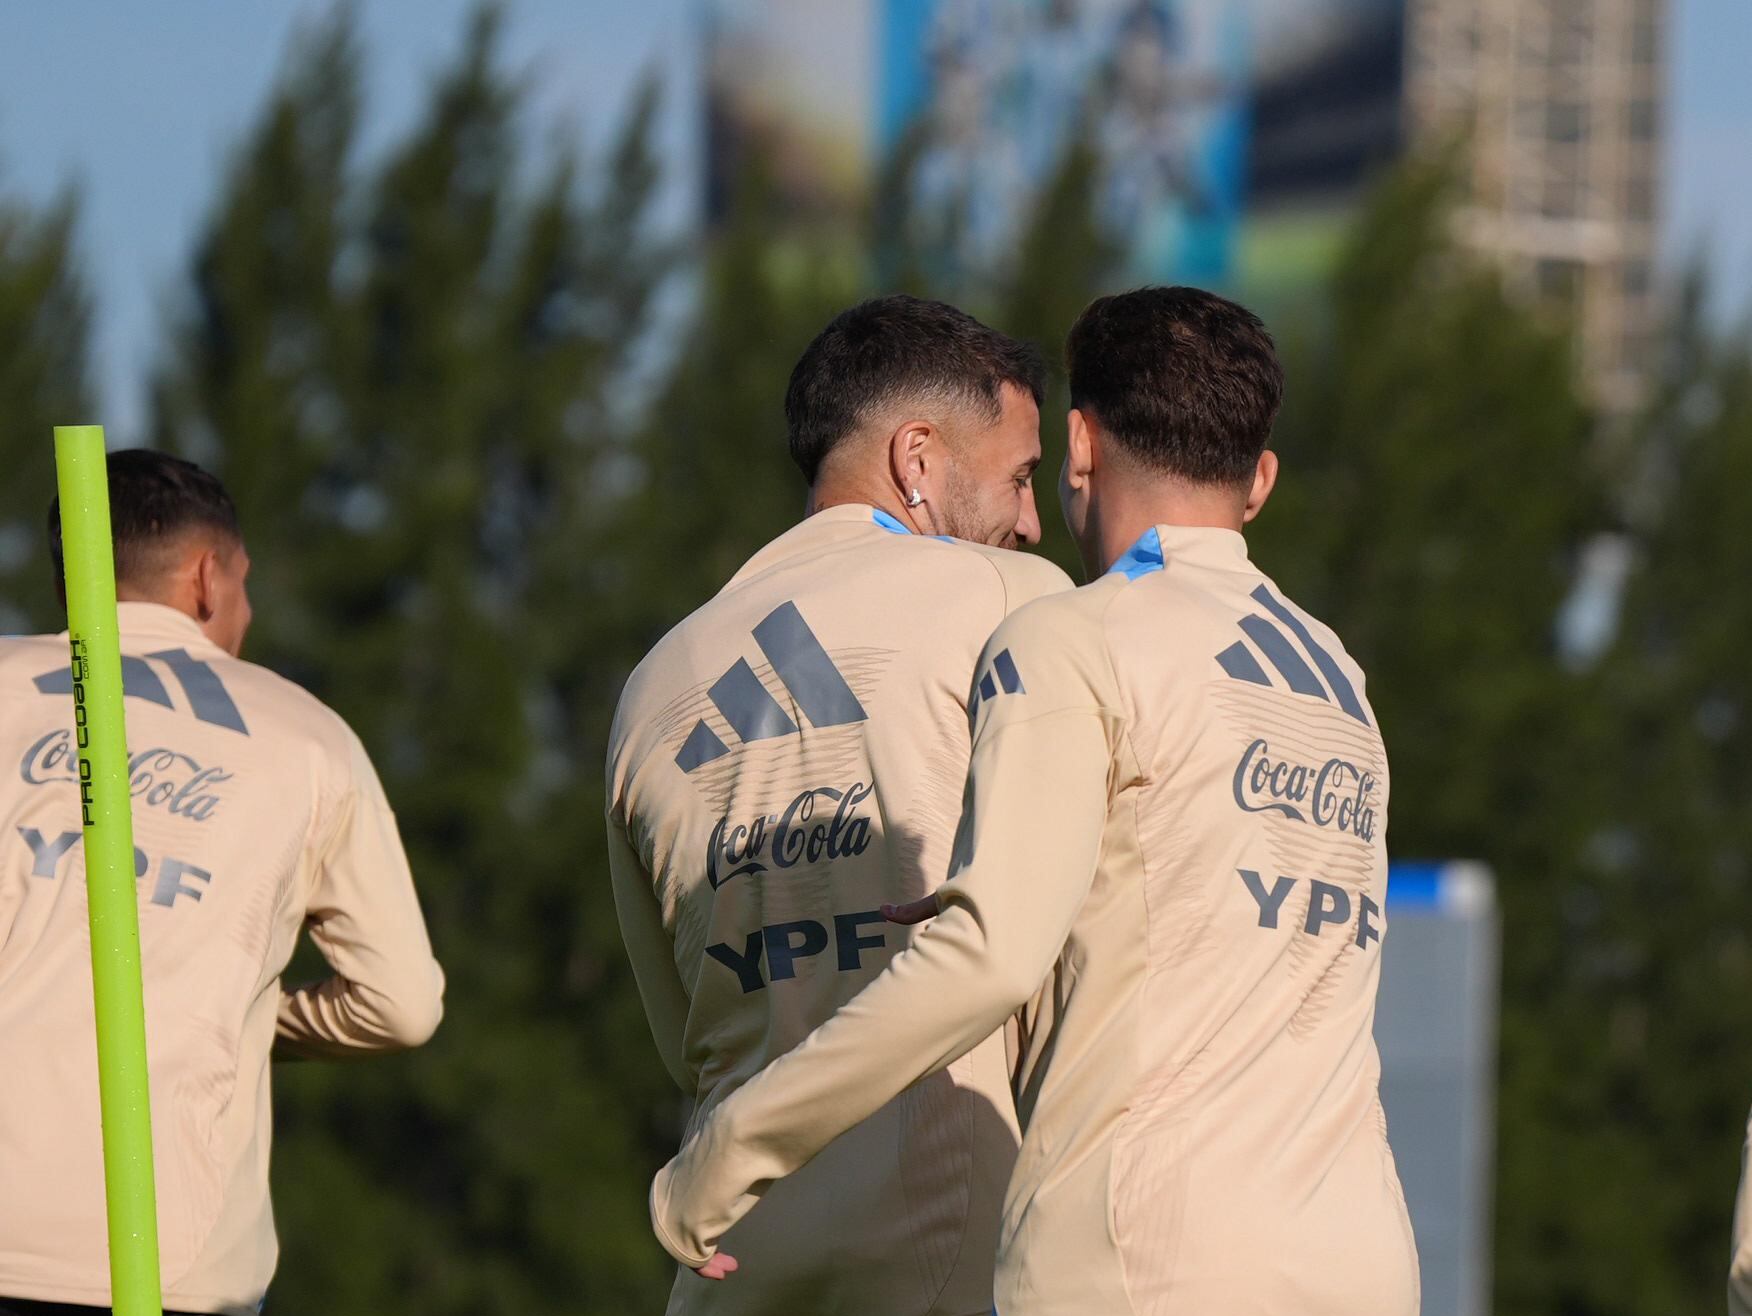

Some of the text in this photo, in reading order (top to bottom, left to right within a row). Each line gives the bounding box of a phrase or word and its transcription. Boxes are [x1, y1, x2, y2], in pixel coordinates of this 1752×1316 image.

[79, 758, 95, 827] PRO
[1232, 738, 1375, 843] Coca-Cola
[706, 779, 875, 892] Cca-Cola
[1236, 868, 1380, 950] YPF
[705, 910, 887, 994] YPF
